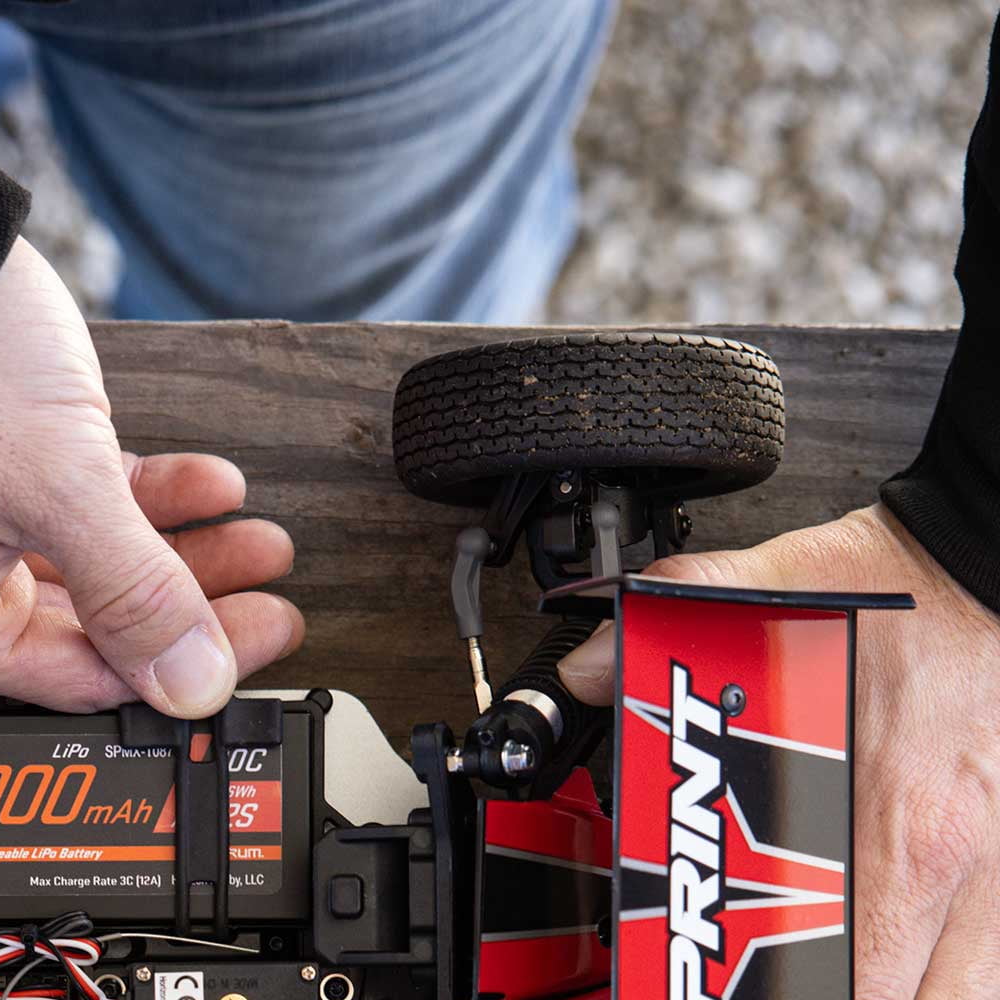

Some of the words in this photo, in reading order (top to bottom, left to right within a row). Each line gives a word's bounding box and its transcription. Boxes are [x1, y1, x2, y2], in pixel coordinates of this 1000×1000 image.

[52, 743, 90, 759] LiPo
[31, 847, 56, 859] LiPo
[58, 847, 103, 862] Battery
[30, 876, 51, 887] Max
[53, 875, 90, 889] Charge
[93, 875, 117, 887] Rate
[119, 875, 134, 887] 3C
[245, 874, 265, 886] LLC
